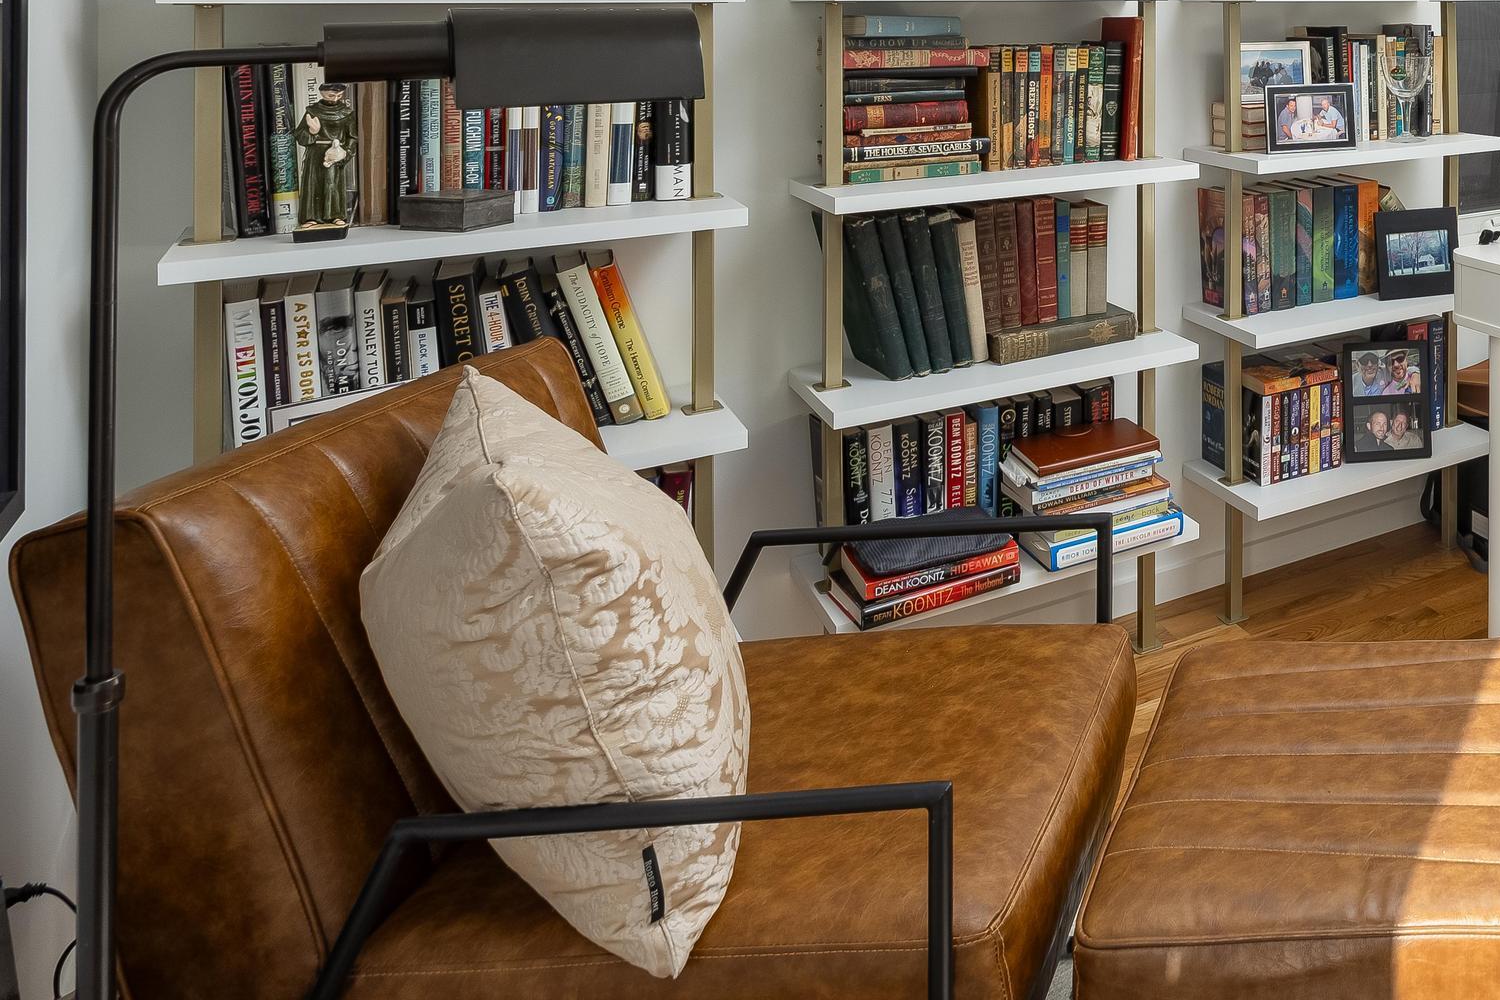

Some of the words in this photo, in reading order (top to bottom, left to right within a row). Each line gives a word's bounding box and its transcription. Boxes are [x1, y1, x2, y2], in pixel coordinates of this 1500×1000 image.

[1028, 80, 1036, 110] GREEN
[240, 102, 255, 123] THE
[275, 106, 285, 134] Woods
[430, 119, 439, 132] NEED
[400, 128, 410, 145] The
[466, 111, 481, 152] FULGHUM
[243, 124, 257, 168] BALANCE
[864, 149, 880, 157] THE
[881, 147, 908, 156] HOUSE
[918, 145, 943, 154] SEVEN
[943, 142, 971, 151] GABLES
[400, 145, 410, 179] Innocent
[466, 161, 479, 184] UH-OH
[673, 166, 684, 198] MAN
[247, 188, 262, 215] GORE
[514, 276, 530, 303] JOHN
[567, 272, 579, 286] The
[484, 294, 499, 309] THE
[574, 285, 598, 330] AUDACITY
[599, 270, 616, 303] Graham
[611, 302, 627, 330] Greene
[231, 310, 255, 343] ME
[448, 284, 471, 345] SECRET
[487, 312, 504, 341] 4-HOUR
[363, 308, 377, 357] STANLEY
[392, 308, 401, 366] GREENLIGHTS
[588, 333, 602, 341] of
[625, 339, 636, 352] The
[296, 351, 313, 367] IS
[336, 339, 346, 366] JON
[594, 342, 610, 368] HOPE
[630, 352, 646, 381] Honorary
[234, 345, 259, 409] ELTON
[577, 358, 589, 377] COURT
[639, 380, 653, 402] Consul
[951, 418, 961, 437] DEAN
[849, 442, 862, 488] KOONTZ
[870, 434, 883, 486] KOONTZ
[884, 441, 892, 474] DEAN
[901, 433, 910, 481] KOONTZ
[910, 440, 918, 469] DEAN
[927, 427, 943, 485] KOONTZ
[951, 439, 962, 479] KOONTZ
[981, 427, 995, 477] KOONTZ
[965, 448, 976, 486] KOONTZ
[1068, 482, 1090, 493] DEAD
[1092, 479, 1102, 487] OF
[1104, 471, 1135, 485] WINTER
[881, 489, 893, 505] 77
[1037, 497, 1064, 511] ROWAN
[1065, 491, 1098, 503] WILLIAMS
[1114, 538, 1126, 547] THE
[1126, 530, 1151, 543] LINCOLN
[1152, 525, 1176, 536] HIGHWAY
[950, 555, 1004, 576] HIDEAWAY
[875, 585, 904, 597] DEAN
[905, 571, 945, 589] KOONTZ
[961, 585, 973, 594] The
[974, 575, 1004, 591] Husband
[873, 612, 892, 622] DEAN
[893, 587, 954, 619] KOONTZ
